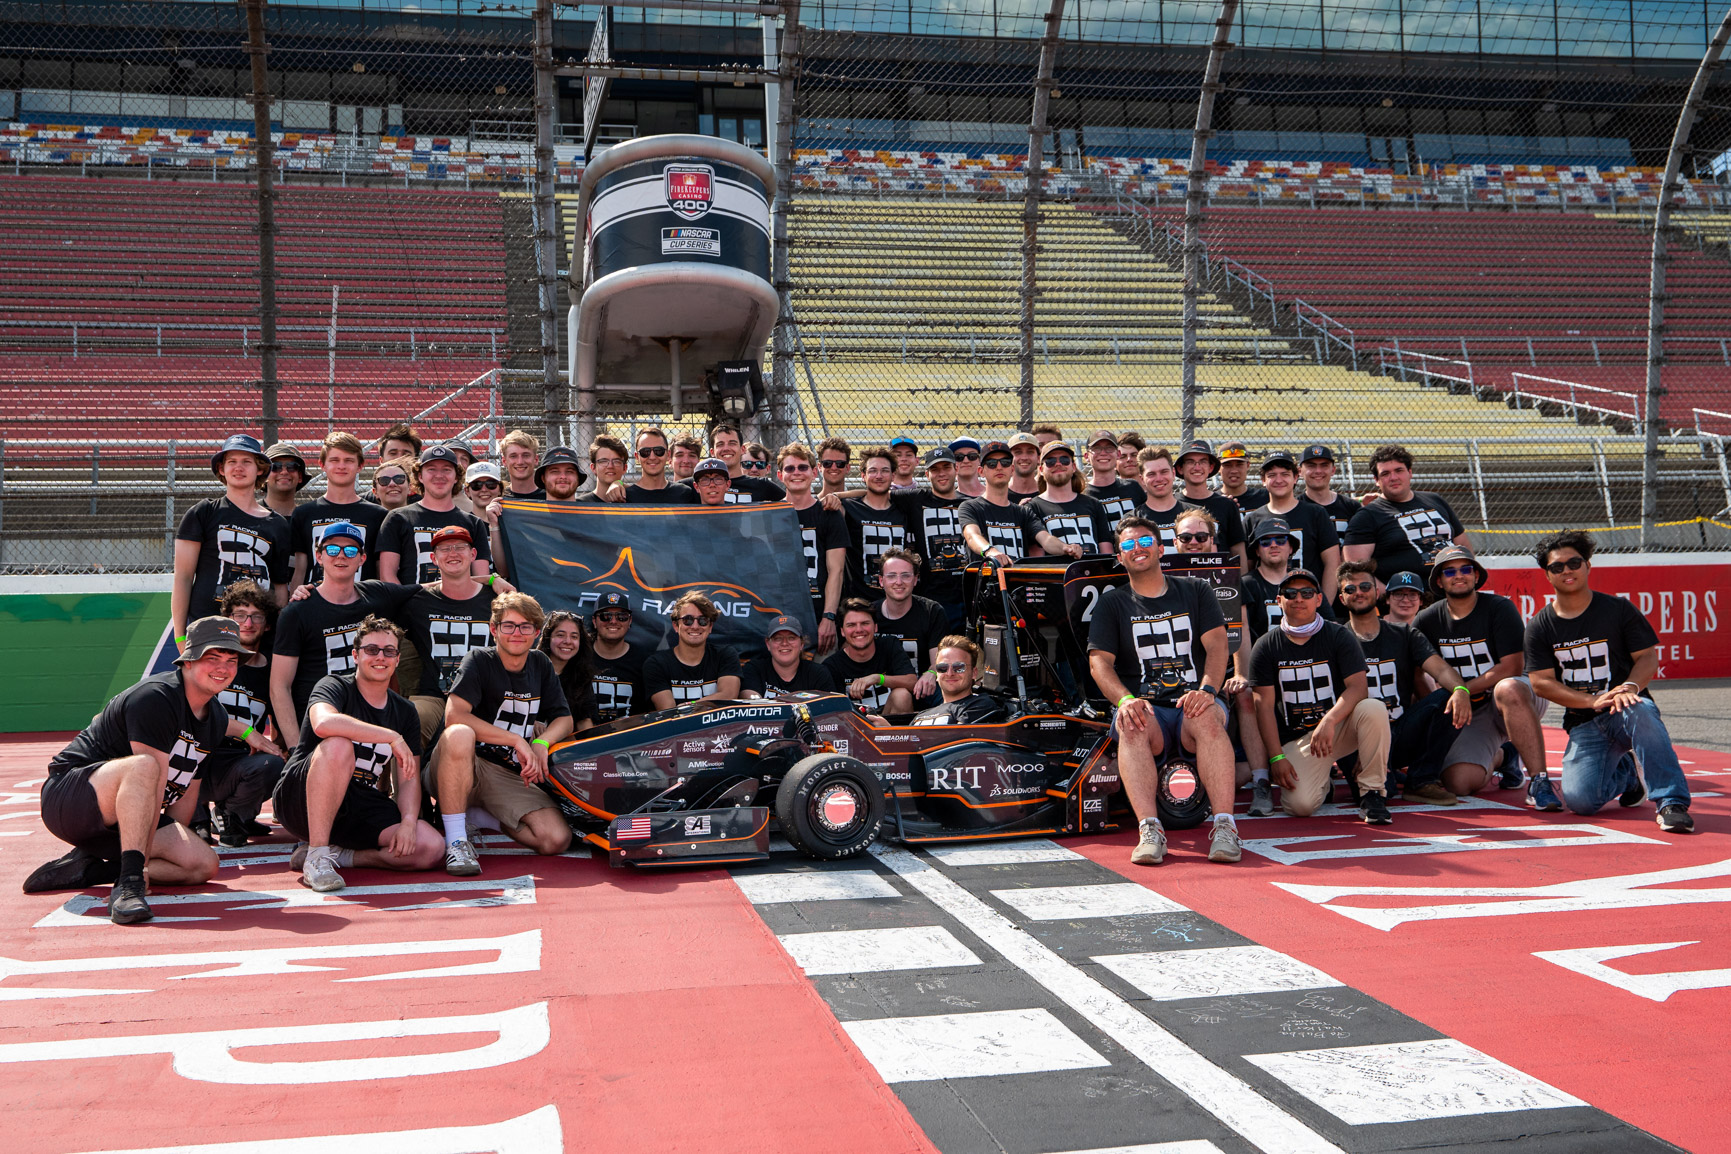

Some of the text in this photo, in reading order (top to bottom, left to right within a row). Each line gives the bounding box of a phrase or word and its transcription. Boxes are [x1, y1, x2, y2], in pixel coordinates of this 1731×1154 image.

[673, 200, 707, 210] 400
[680, 230, 712, 238] NASCAR
[686, 241, 712, 249] SERIES
[642, 598, 751, 617] RANG
[1144, 611, 1172, 620] RACING
[1564, 637, 1590, 646] RACING
[1655, 645, 1694, 660] TEL
[702, 706, 782, 725] QUAD-MOTOR
[746, 724, 780, 735] Ansys
[835, 740, 847, 749] US
[998, 763, 1044, 773] MOOG
[930, 766, 986, 790] RIT
[1089, 774, 1118, 784] Altium
[1003, 786, 1041, 795] SOLIDWORKS
[685, 816, 711, 830] SAE
